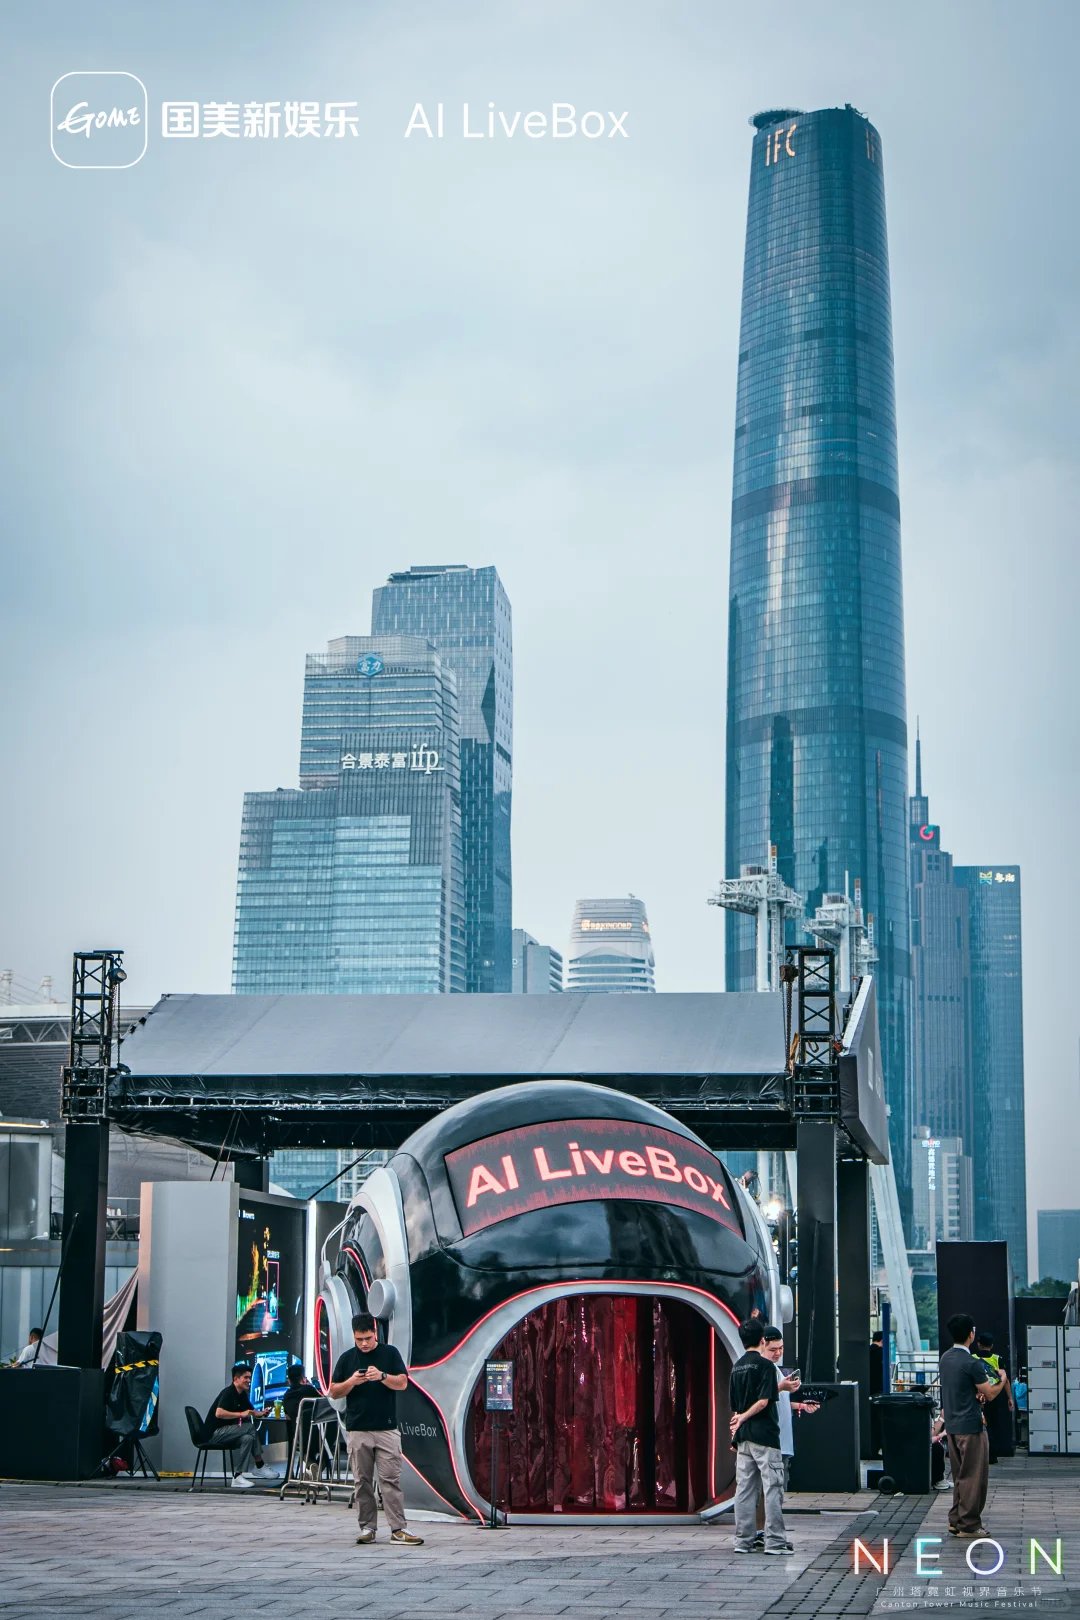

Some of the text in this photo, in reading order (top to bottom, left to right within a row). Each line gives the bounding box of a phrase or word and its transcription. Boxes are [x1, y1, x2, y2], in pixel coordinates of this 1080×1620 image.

[340, 752, 408, 770] 合景泰富
[411, 743, 440, 775] ifp
[466, 1142, 731, 1211] AI LiveBox
[400, 1421, 437, 1437] LiveBox
